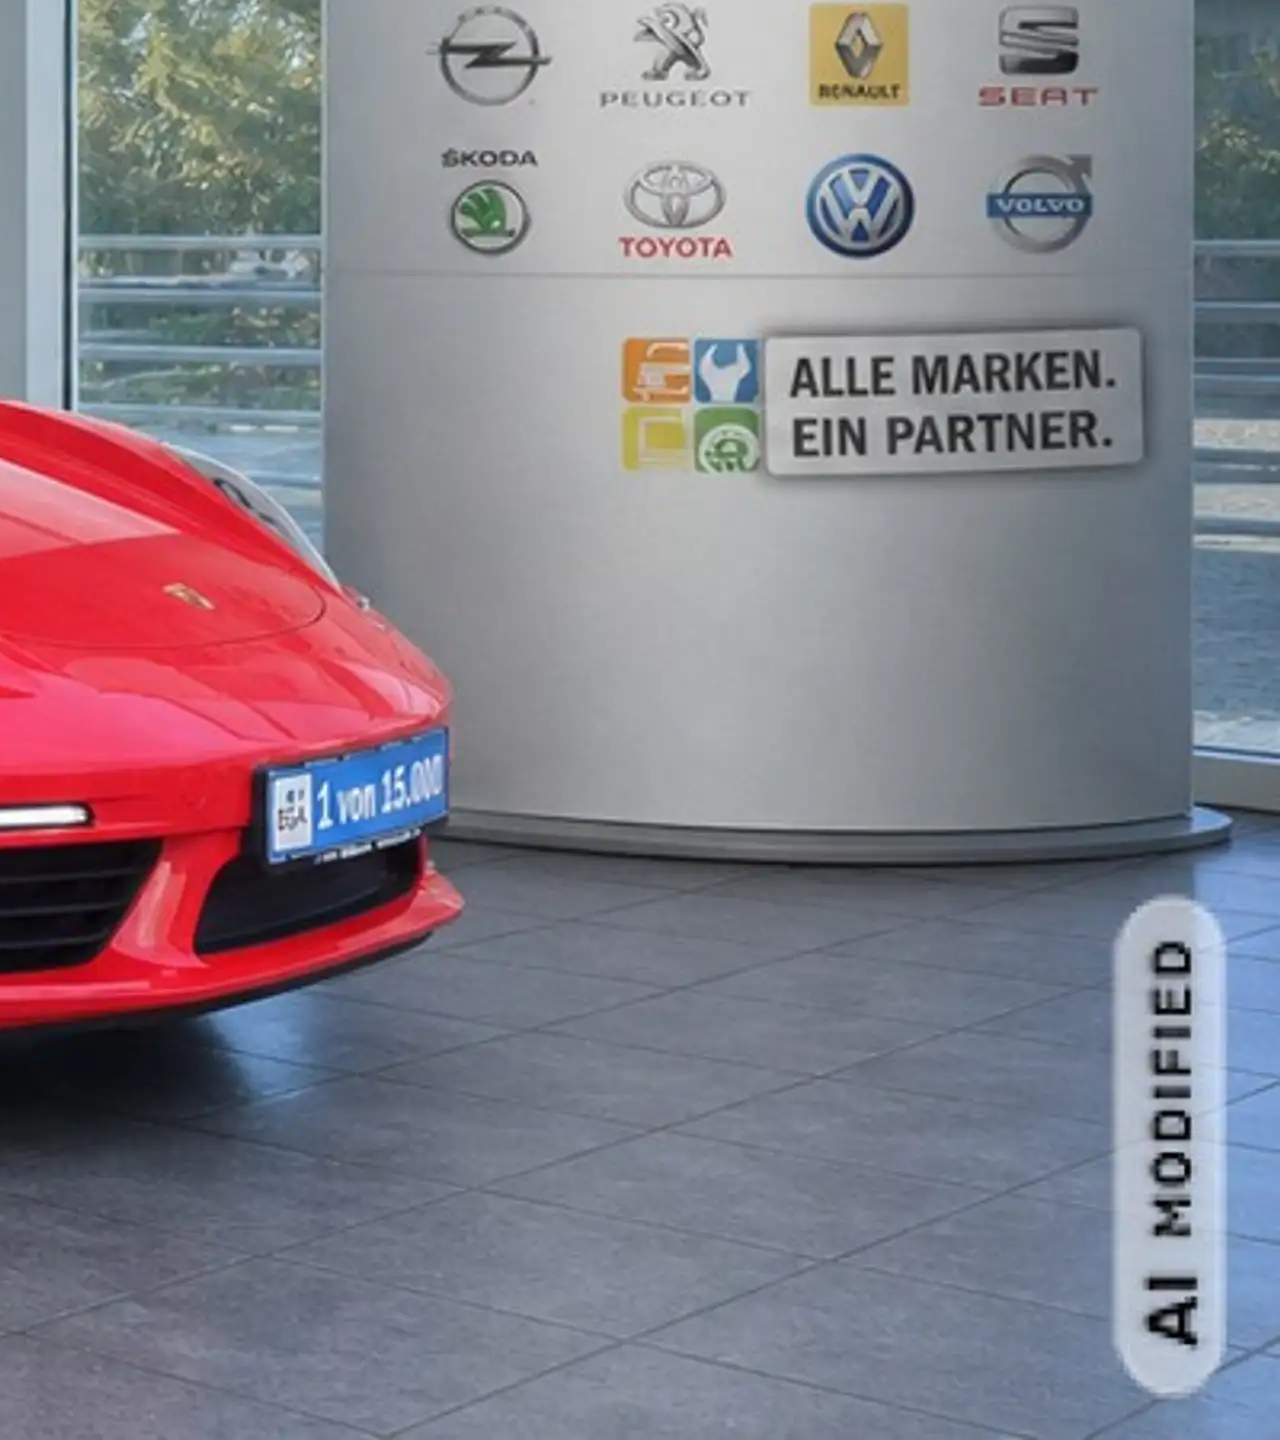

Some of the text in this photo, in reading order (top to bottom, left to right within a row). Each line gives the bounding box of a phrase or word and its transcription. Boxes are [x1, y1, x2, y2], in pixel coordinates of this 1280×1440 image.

[598, 90, 753, 108] PEUGEOT
[818, 83, 901, 100] RENAULT
[977, 86, 1099, 107] SEAT
[995, 197, 1086, 213] VOLVO
[618, 236, 734, 259] TOYOTA
[789, 349, 1117, 398] ALLE MARKEN.
[792, 410, 1114, 458] EIN PARTNER.
[316, 781, 334, 830] 1
[336, 784, 377, 824] von
